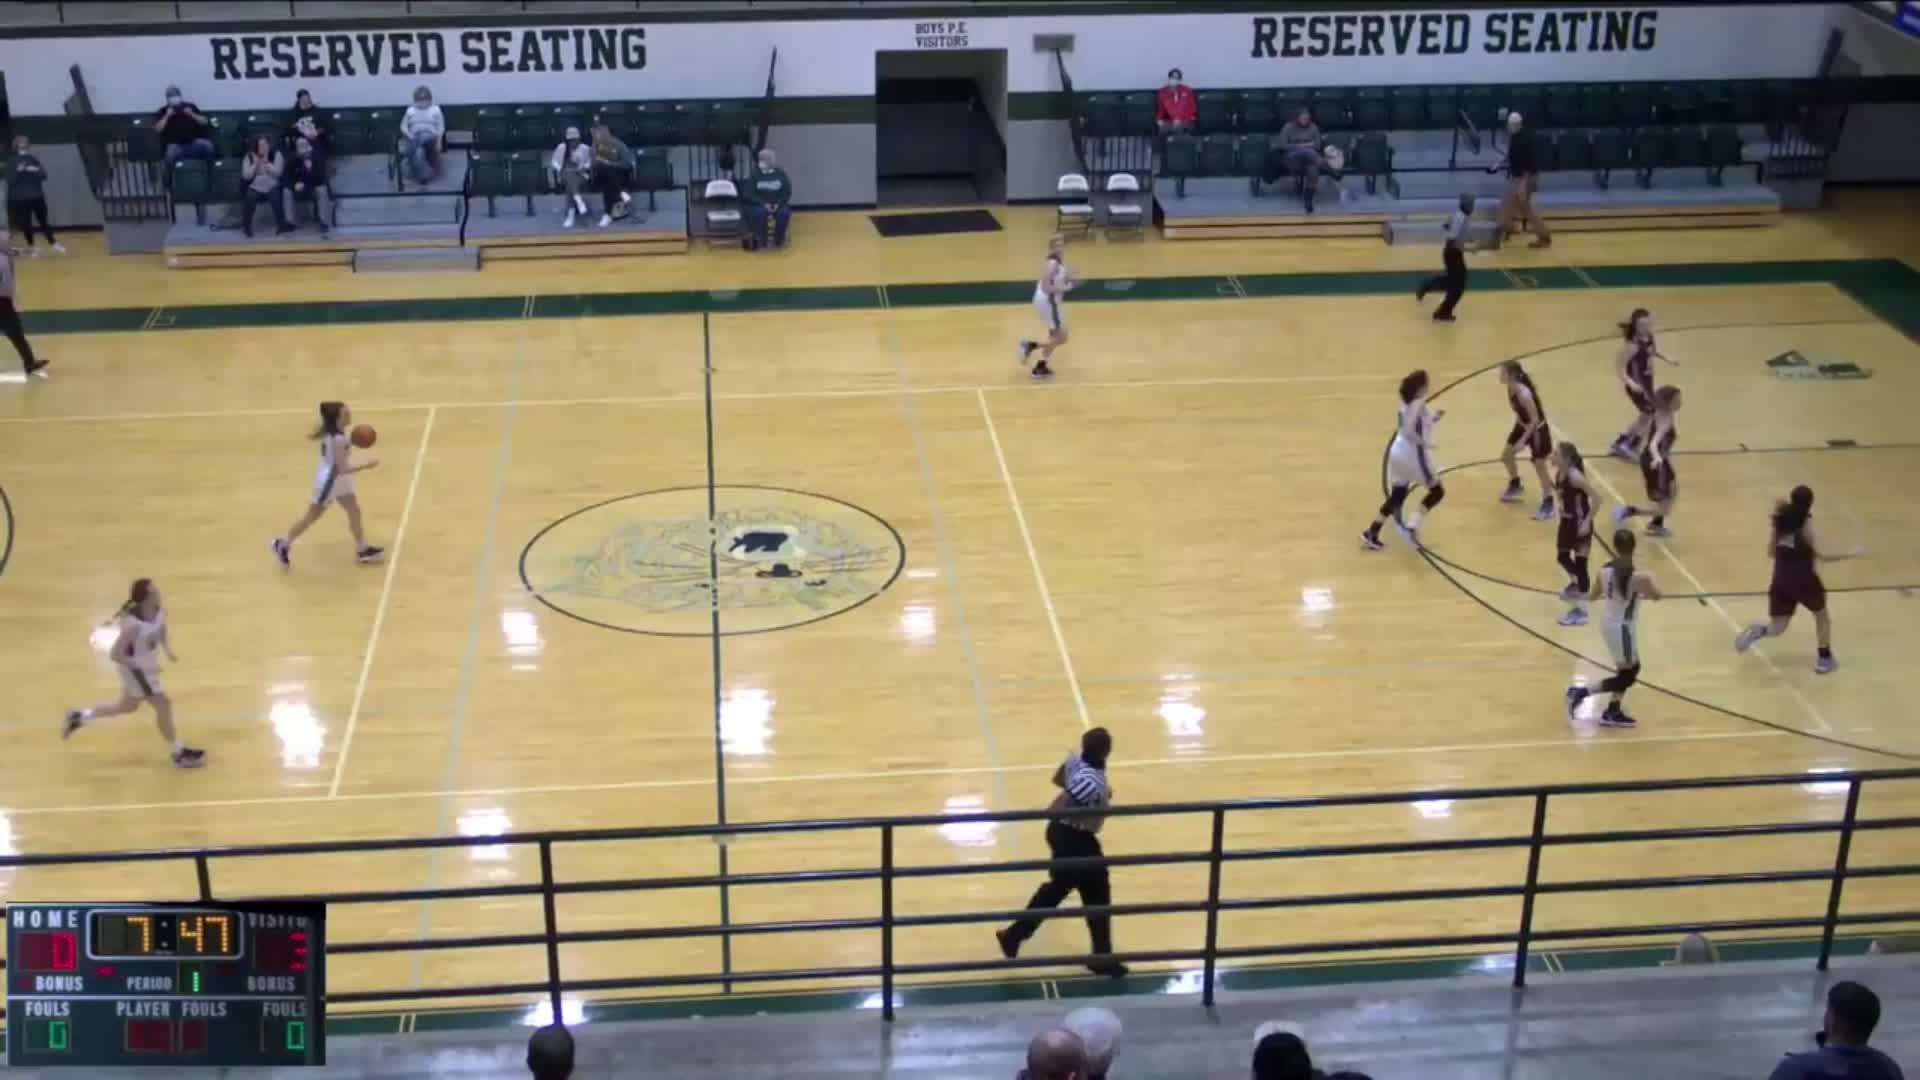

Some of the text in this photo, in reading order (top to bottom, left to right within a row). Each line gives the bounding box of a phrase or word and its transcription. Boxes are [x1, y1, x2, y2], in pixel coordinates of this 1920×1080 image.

[915, 22, 944, 34] BOYS
[915, 35, 968, 48] VISITORS
[1250, 10, 1658, 57] RESERVED SEATING
[209, 27, 647, 80] RESERVED SEATING
